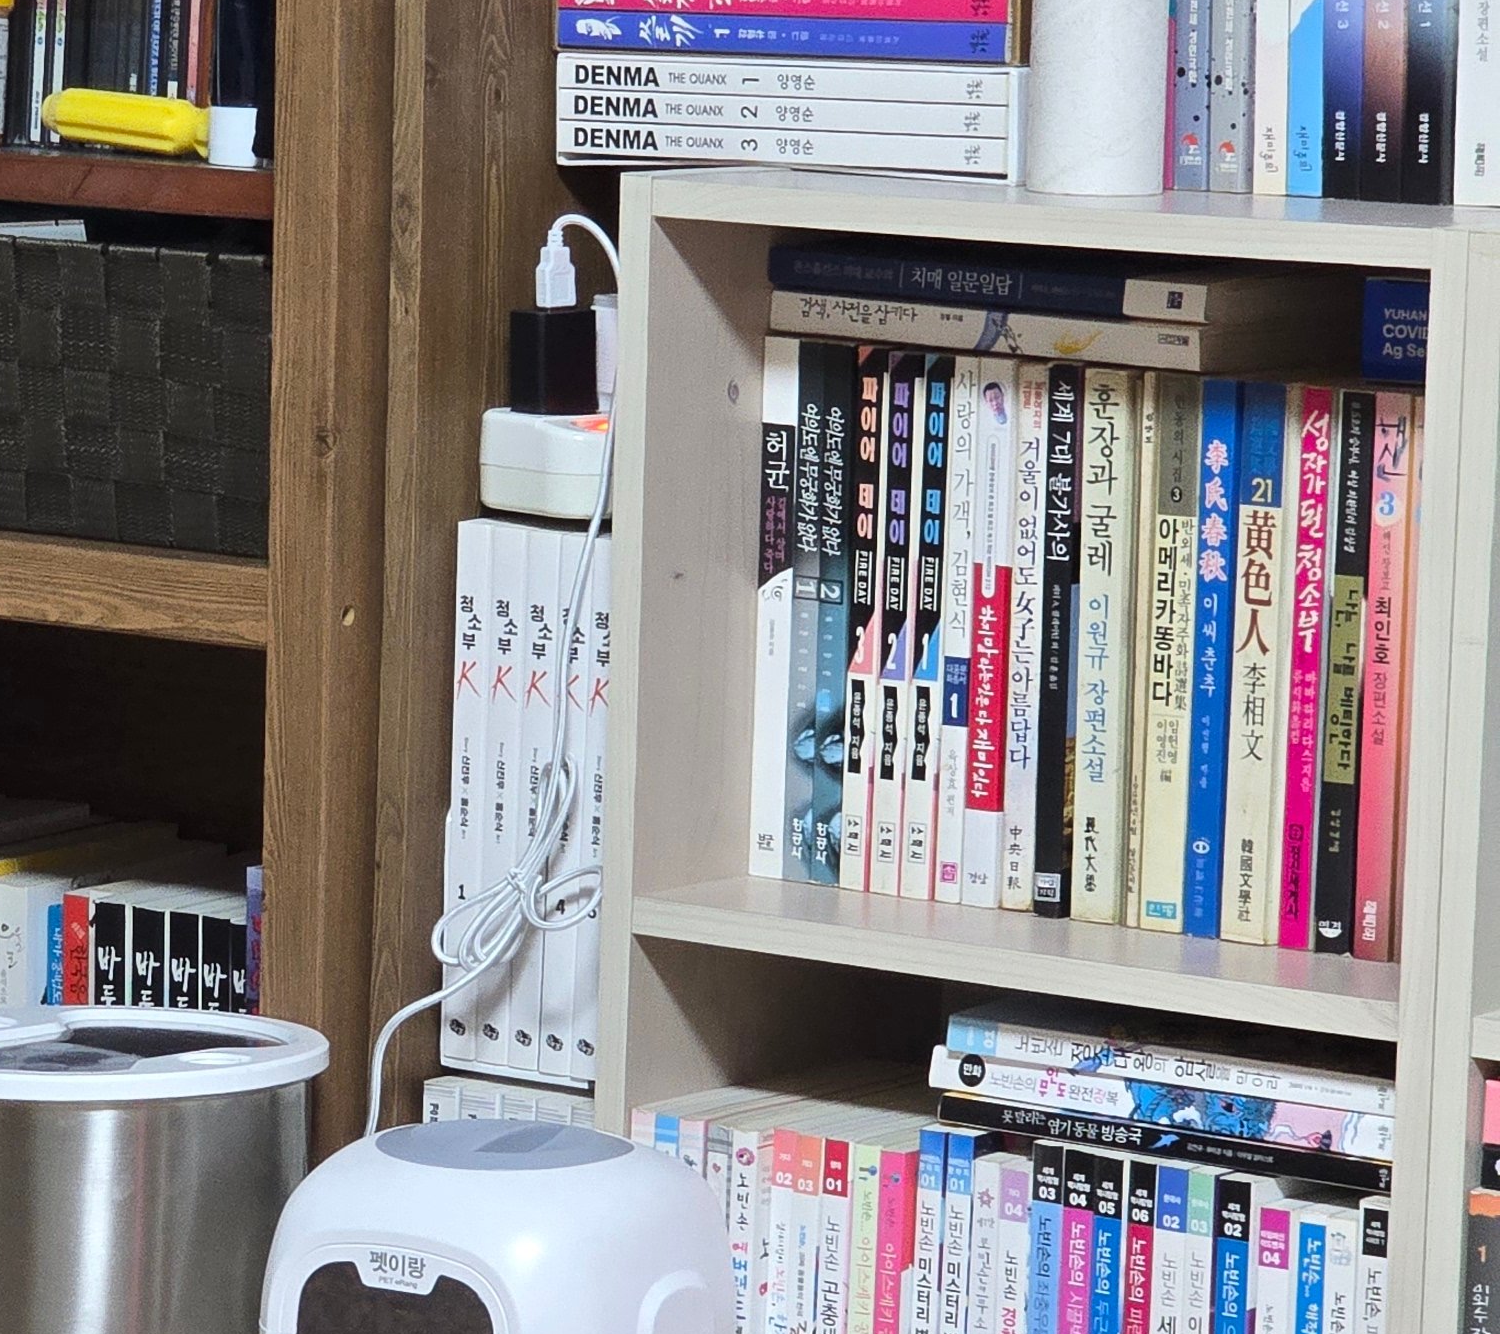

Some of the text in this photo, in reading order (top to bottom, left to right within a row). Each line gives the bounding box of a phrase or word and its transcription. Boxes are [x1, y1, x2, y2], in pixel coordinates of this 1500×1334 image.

[574, 65, 687, 87] DENMA THE
[776, 74, 815, 91] 양영순
[574, 95, 657, 119] DENMA
[911, 268, 942, 290] 치매
[947, 270, 1012, 296] 일문일답
[799, 296, 918, 326] 검색, 사전을 삼키다
[1382, 343, 1402, 358] Ag
[954, 370, 977, 453] 사랑의
[1047, 381, 1075, 562] 세계 불가사의
[1086, 384, 1120, 577] 훈장과 굴레
[1251, 478, 1273, 503] 21
[796, 522, 820, 553] 없다
[1016, 437, 1041, 586] 거울이 없어도
[1199, 439, 1229, 583] 李氏春秋
[1296, 409, 1330, 653] 성자가 청소부
[857, 551, 869, 604] FIRE DAY
[456, 595, 482, 701] 청소부 K
[491, 599, 518, 706] 청소부 K
[530, 604, 553, 660] 청소부
[1199, 593, 1218, 698] 이씨춘추
[1373, 595, 1392, 665] 최인호
[1082, 594, 1110, 783] 이원규 장편소설
[1241, 663, 1266, 761] 李相文
[971, 728, 995, 797] 재미있다
[1047, 1118, 1143, 1144] 엽기 동물 방송국
[825, 1175, 843, 1192] 01
[1037, 1186, 1056, 1200] 03
[1068, 1194, 1087, 1207] 04
[1097, 1201, 1116, 1216] 05
[1132, 1209, 1149, 1223] 06
[1223, 1223, 1243, 1237] 02
[368, 1250, 428, 1280] 펫이랑
[824, 1217, 841, 1271] 노빈손
[1067, 1221, 1086, 1287] 노빈손의
[914, 1257, 933, 1324] 미스터리
[1365, 1267, 1383, 1322] 노빈손,
[1473, 1283, 1490, 1322] 이외수
